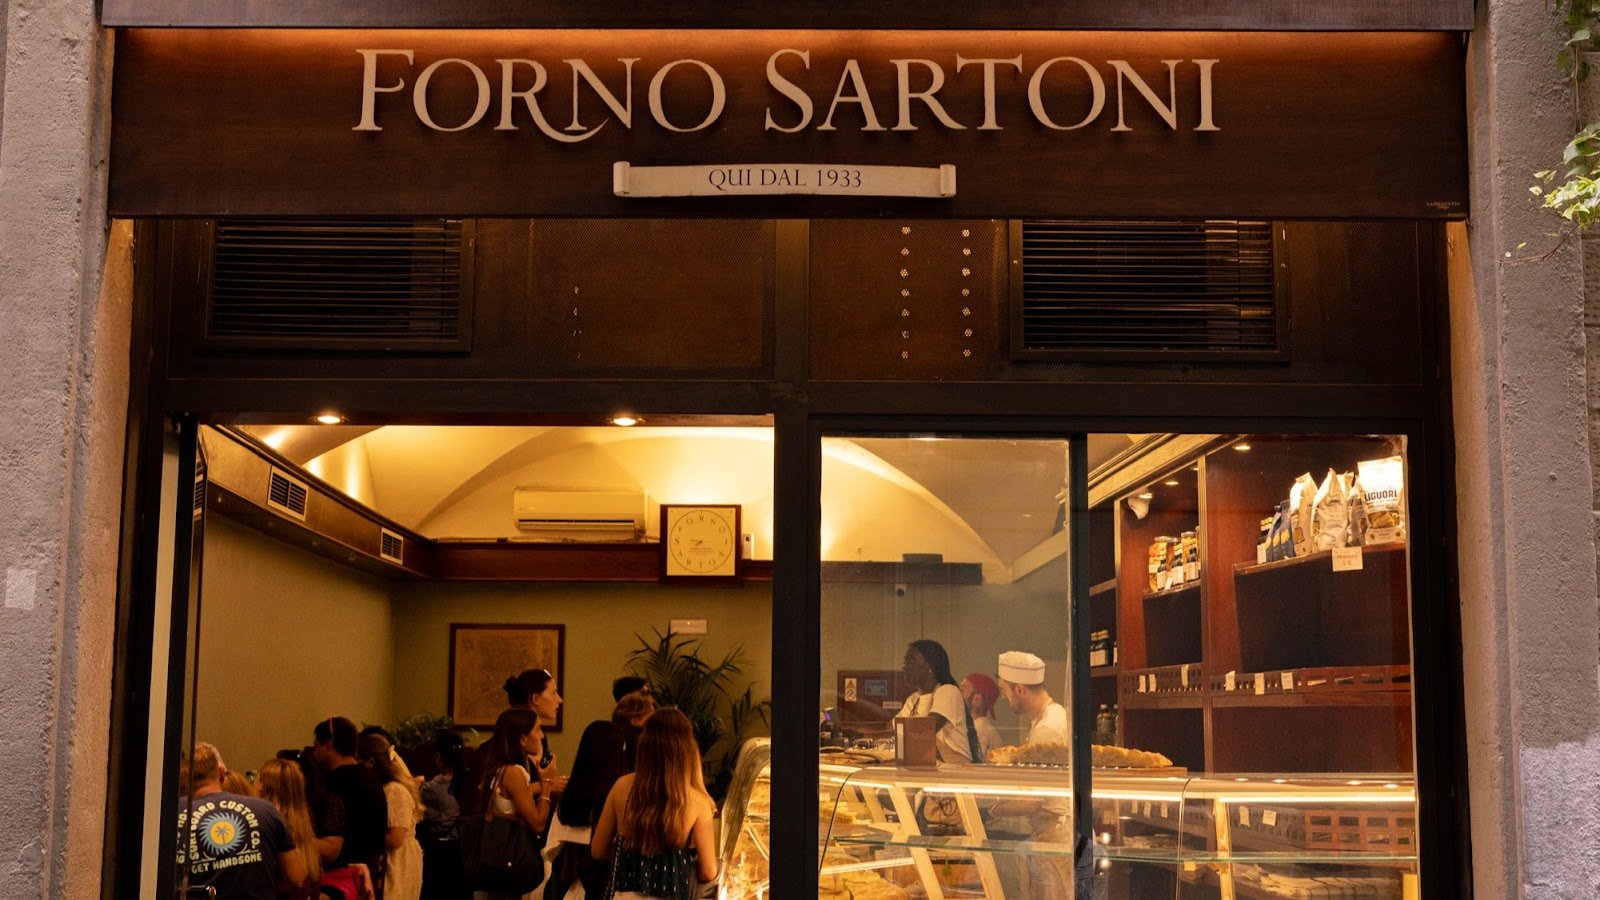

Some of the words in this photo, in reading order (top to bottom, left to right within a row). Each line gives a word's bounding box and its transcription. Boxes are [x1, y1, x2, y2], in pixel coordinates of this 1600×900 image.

[352, 49, 726, 142] FORNO
[764, 48, 1221, 133] SARTONI
[708, 169, 751, 191] QUI
[760, 169, 806, 186] DAL
[817, 169, 862, 187] 1933
[219, 800, 259, 828] CUSTOM
[191, 862, 210, 874] GET
[212, 852, 263, 870] HANDSOME
